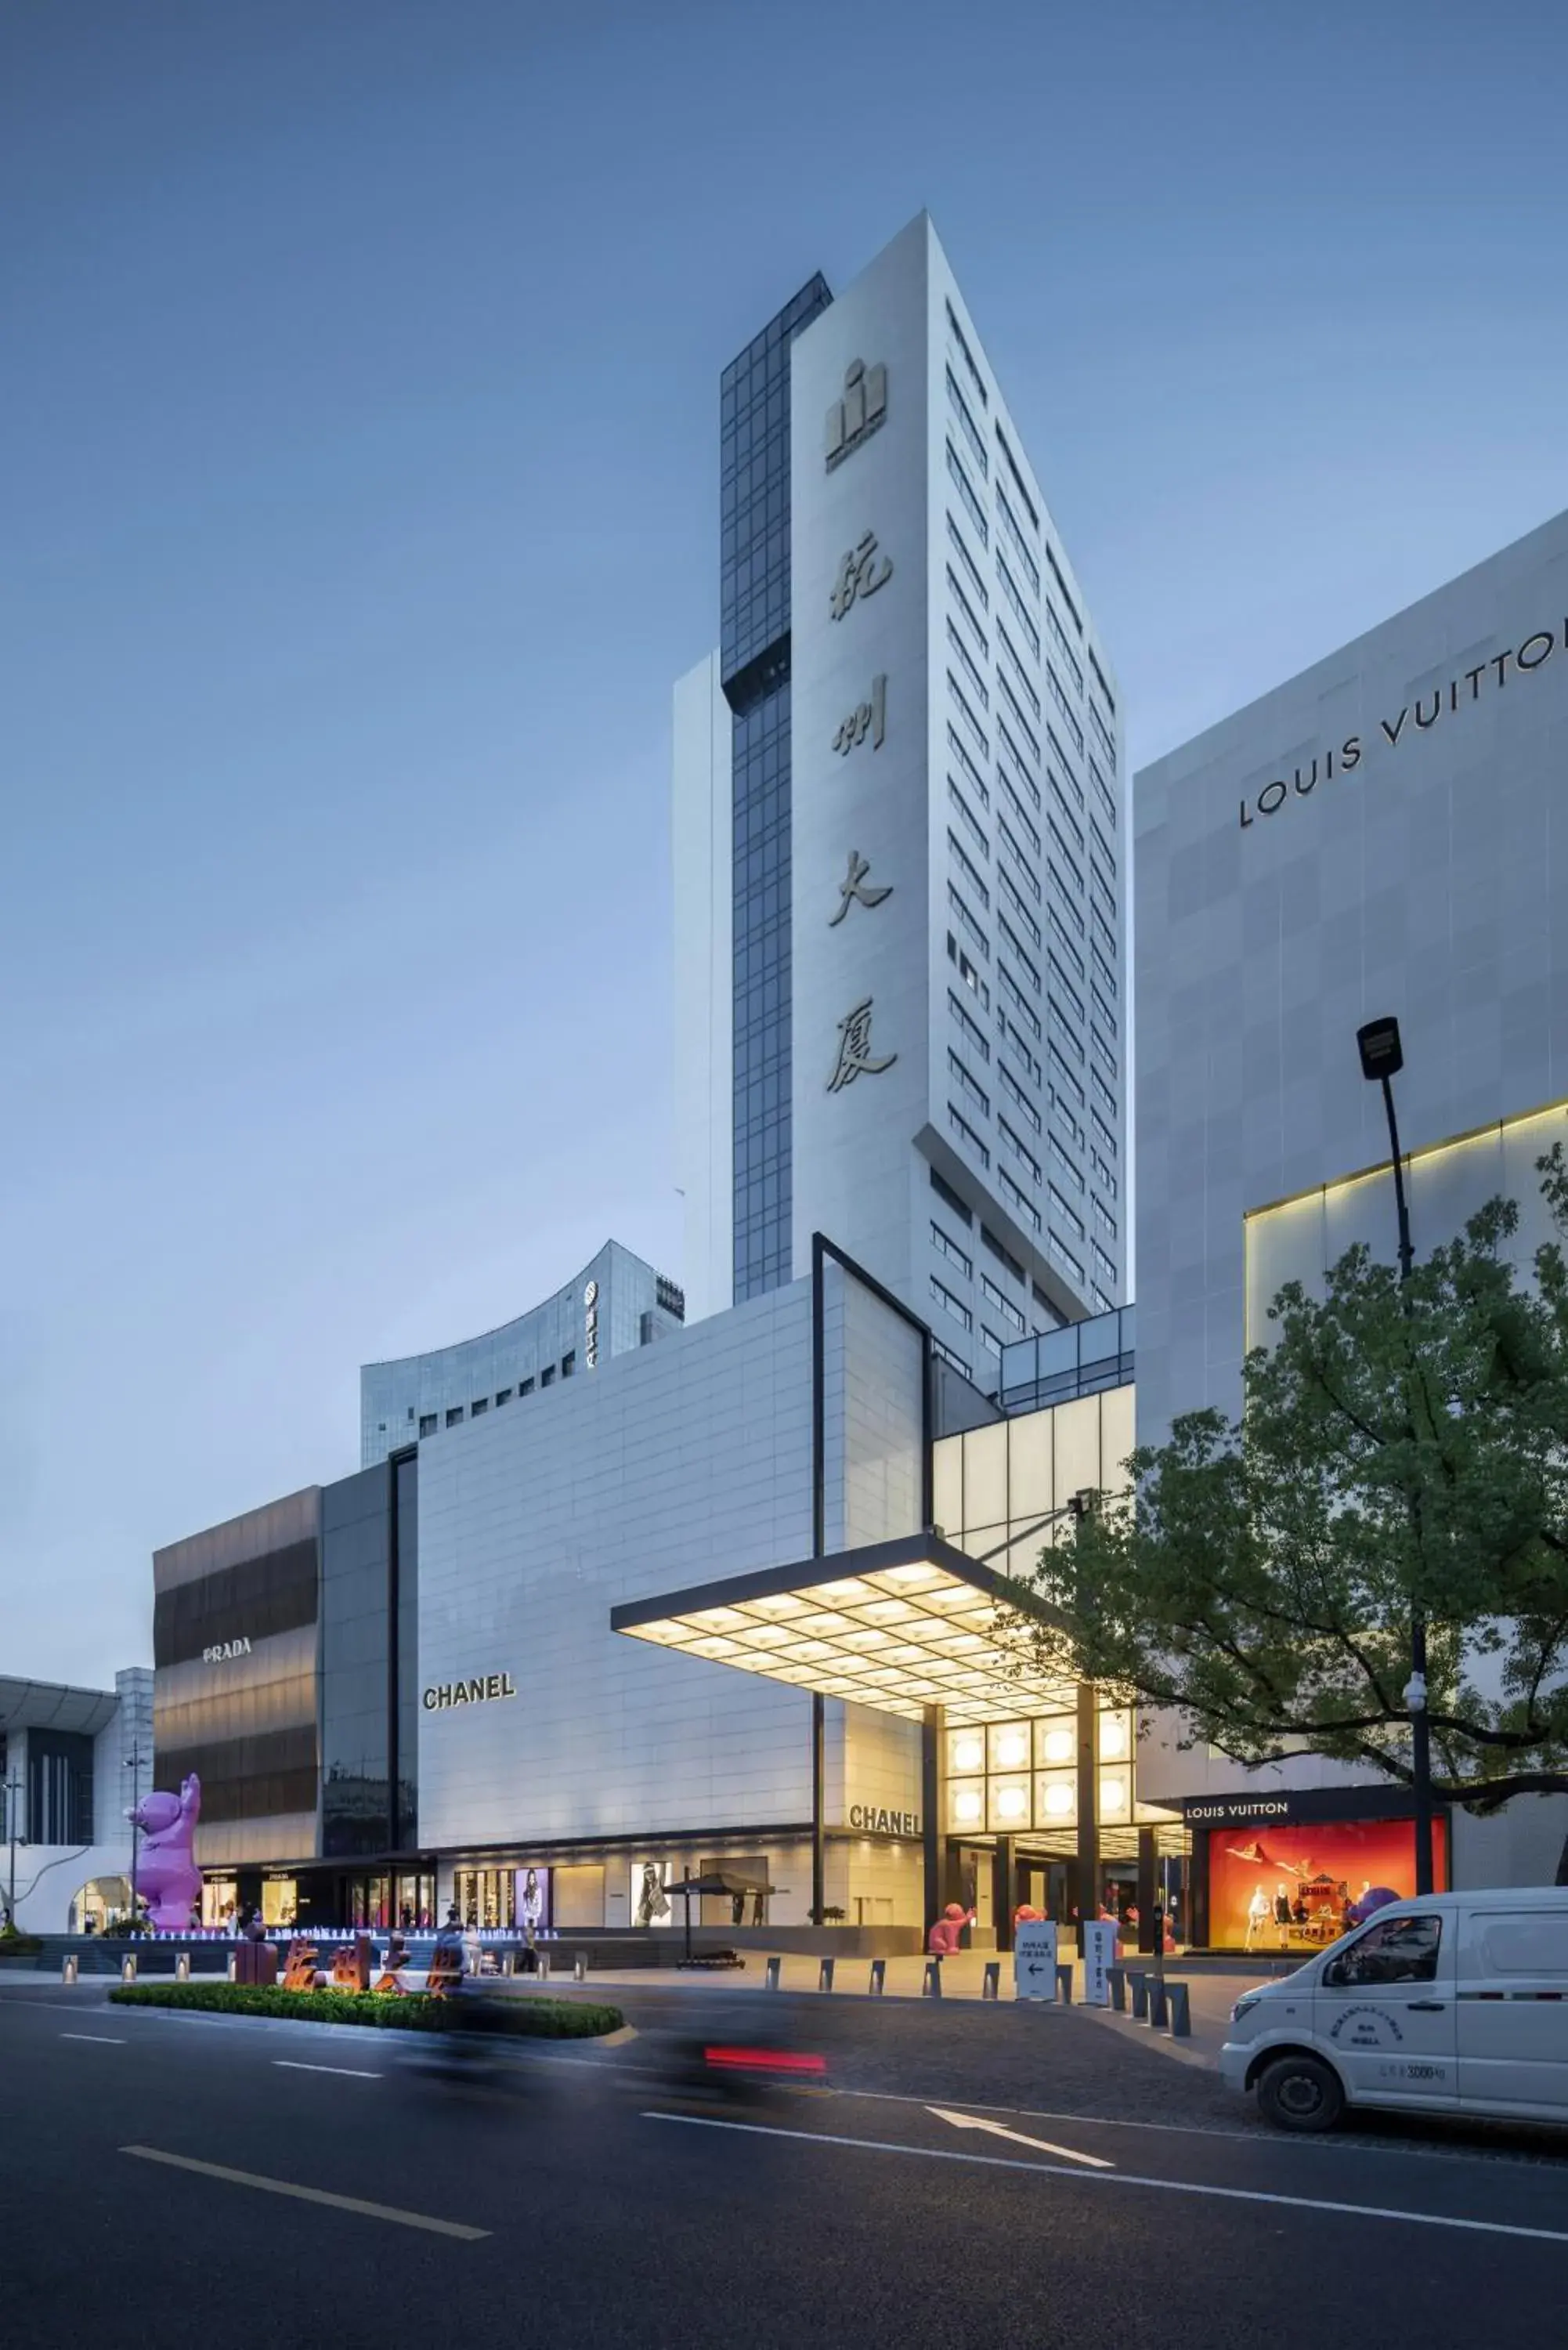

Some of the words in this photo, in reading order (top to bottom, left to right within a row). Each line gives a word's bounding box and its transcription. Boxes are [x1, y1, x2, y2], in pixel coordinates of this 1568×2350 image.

[1238, 736, 1361, 828] LOUIS
[1381, 617, 1568, 747] VUITTO
[202, 1637, 251, 1663] PRADA
[423, 1672, 516, 1711] CHANEL
[850, 1804, 923, 1835] CHANEL
[1187, 1806, 1224, 1818] LOUIS
[1229, 1802, 1288, 1816] VUITTON
